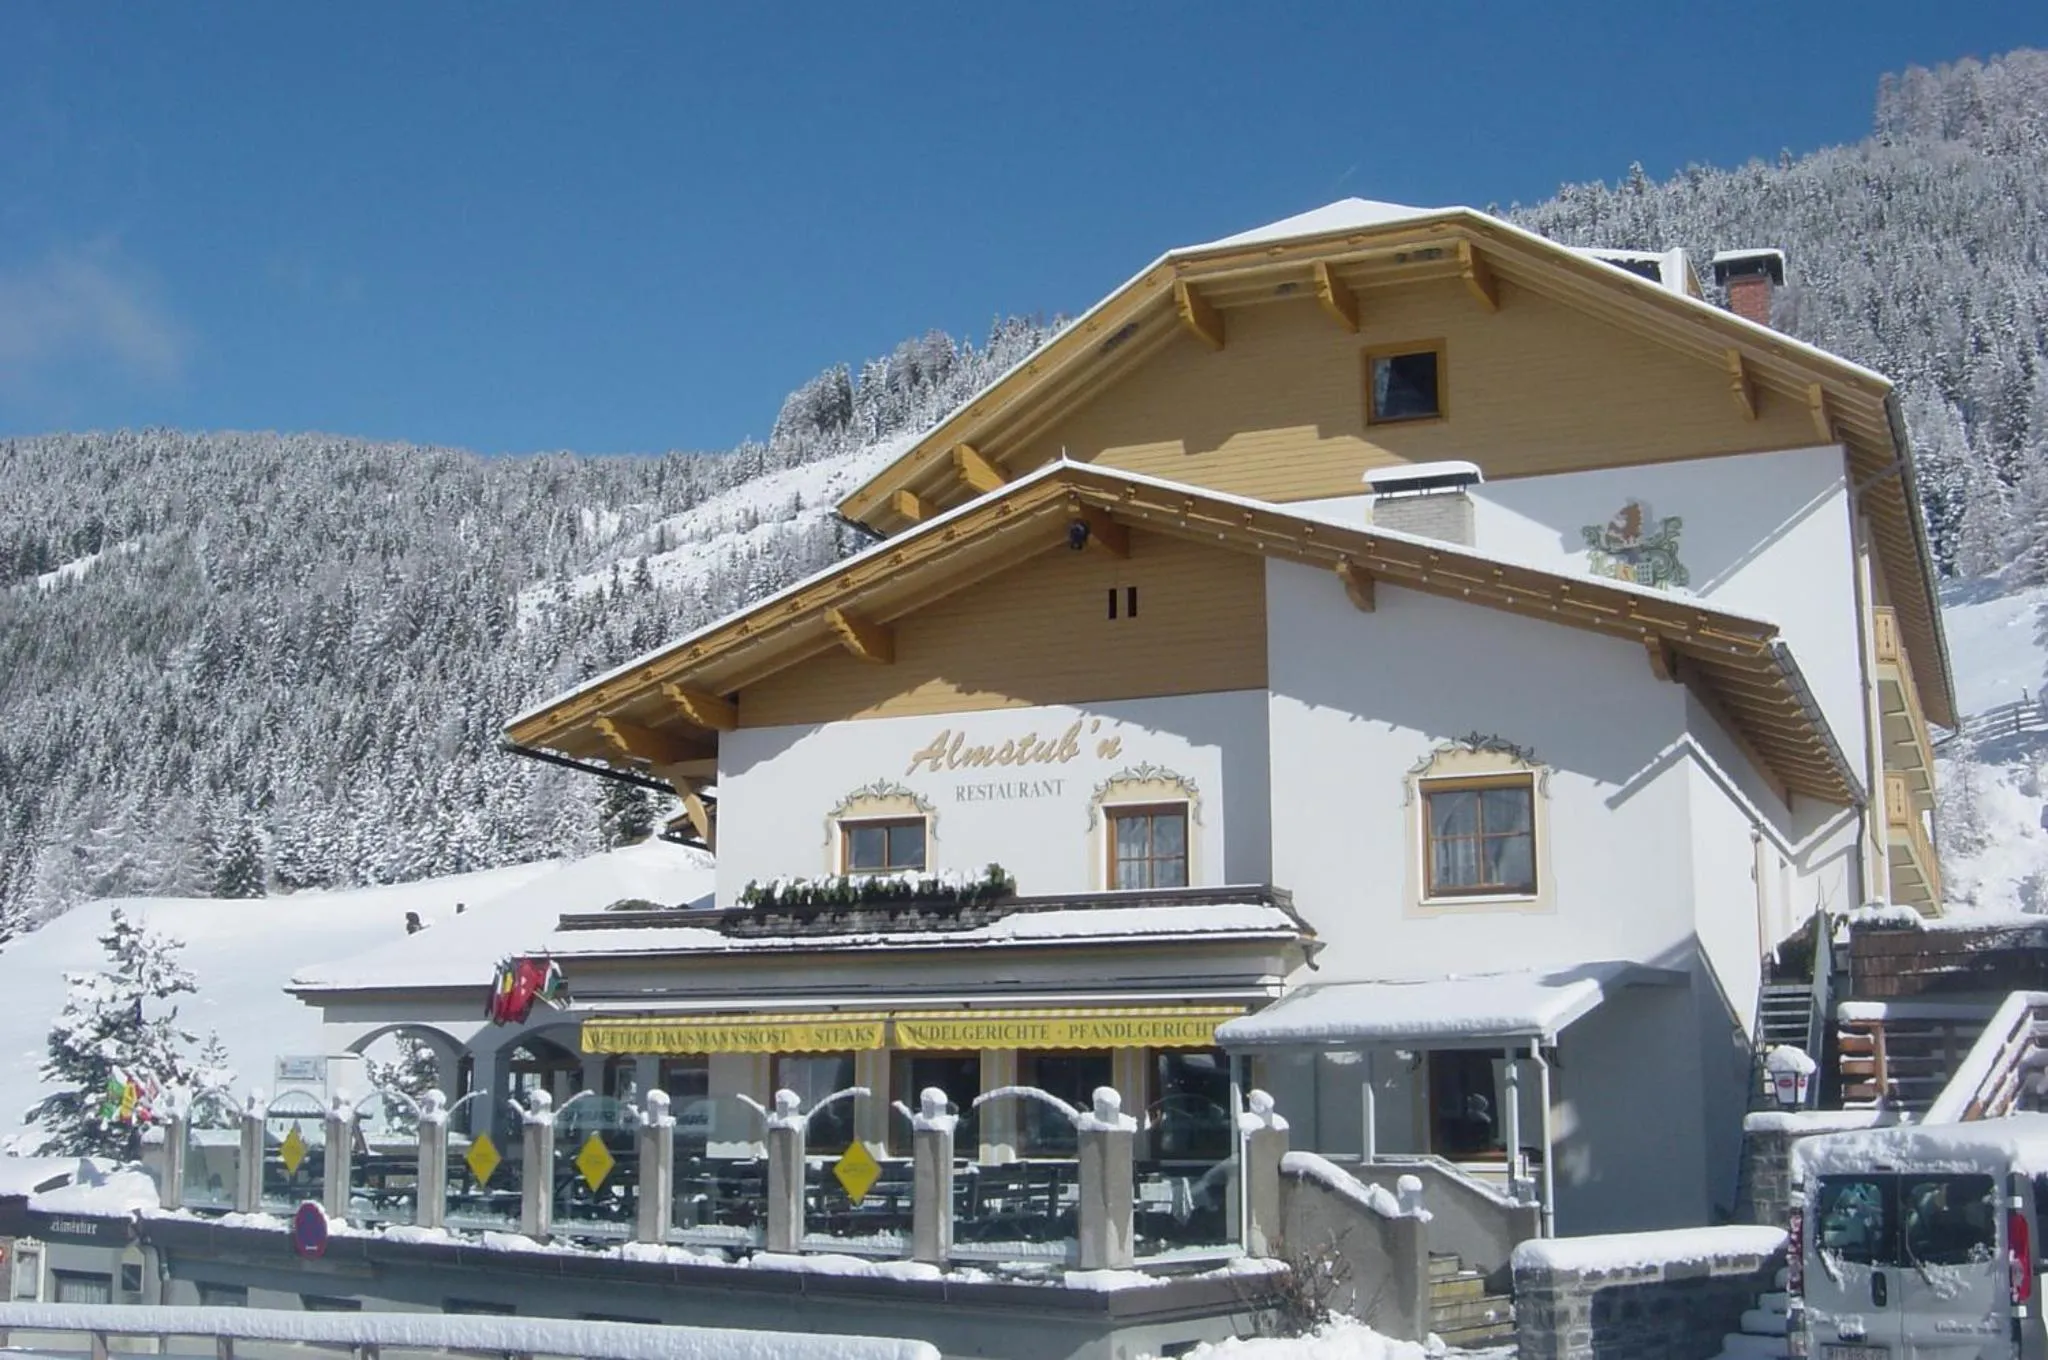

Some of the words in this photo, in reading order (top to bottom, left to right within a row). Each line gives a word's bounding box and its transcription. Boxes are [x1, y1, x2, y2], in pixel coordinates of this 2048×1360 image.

[905, 718, 1123, 776] Almstub'n
[956, 779, 1064, 801] RESTAURANT
[815, 1026, 876, 1043] STEAKS
[907, 1023, 1049, 1041] NUDELGERICHTE
[1069, 1021, 1222, 1039] PFANDLGERICHT
